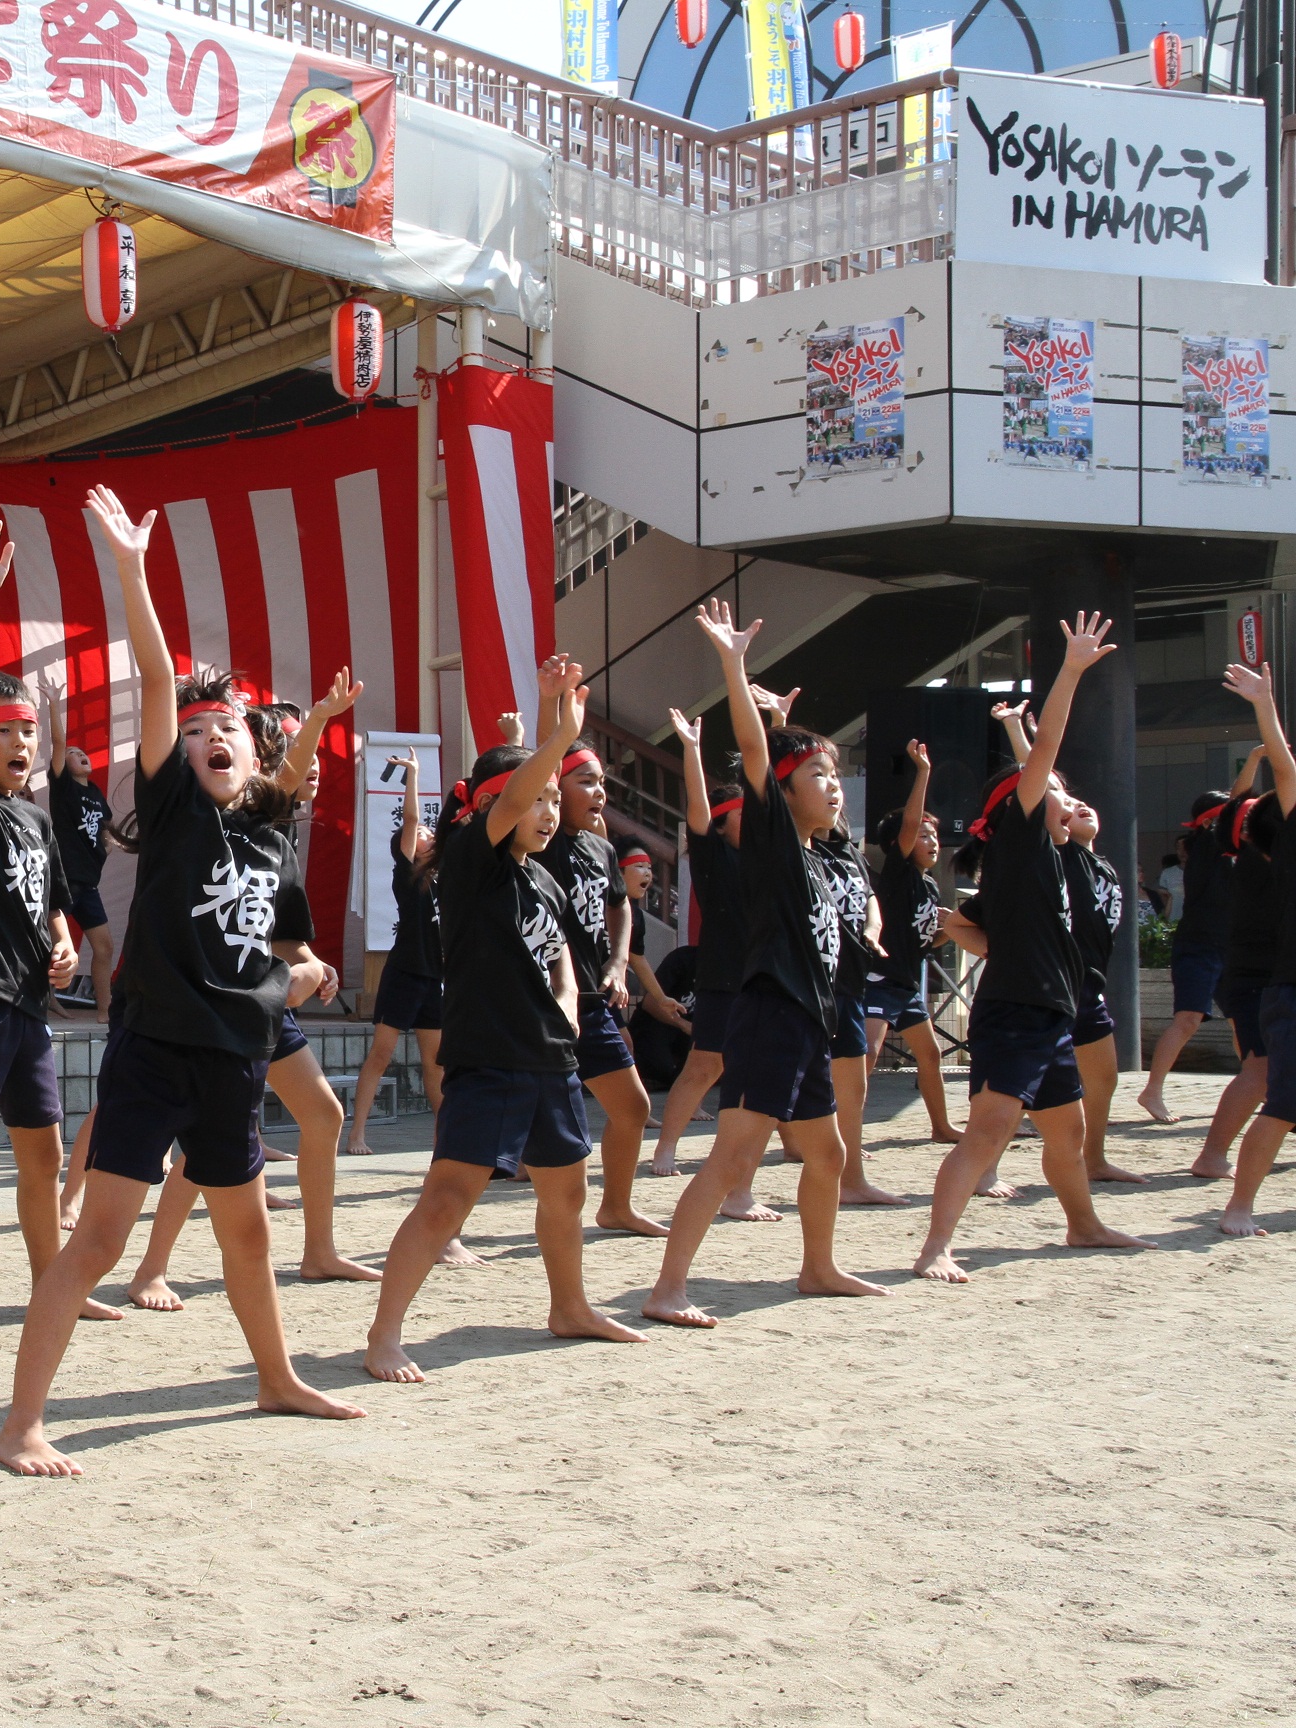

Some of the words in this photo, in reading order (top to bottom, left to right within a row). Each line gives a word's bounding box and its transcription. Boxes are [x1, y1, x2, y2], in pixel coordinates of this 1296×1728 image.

[966, 96, 1117, 192] YOSAKOI
[1126, 143, 1252, 201] ソーラン
[1012, 193, 1055, 230] IN
[1065, 190, 1209, 252] HAMURA
[119, 235, 136, 314] 平和亭
[351, 310, 374, 388] 伊勢屋精肉店
[811, 328, 902, 385] YOSAKOI
[1008, 331, 1091, 374] YOSAKOI
[840, 360, 899, 398] ソーラン
[857, 395, 867, 406] IN
[867, 378, 902, 401] HAMURA
[1036, 362, 1089, 392] ソーラン
[1186, 350, 1266, 393] YOSAKOI
[862, 408, 871, 417] 21
[881, 405, 892, 414] 22
[1050, 393, 1060, 402] IN
[1055, 405, 1064, 414] 21
[1072, 406, 1082, 415] 22
[1214, 380, 1265, 410] ソーラン
[1228, 410, 1238, 419] IN
[1232, 423, 1241, 431] 21
[1249, 424, 1259, 432] 22
[77, 805, 104, 849] 輝
[4, 838, 48, 926] 輝
[827, 872, 868, 934] 輝
[191, 858, 280, 974] 輝
[569, 873, 610, 945] 輝
